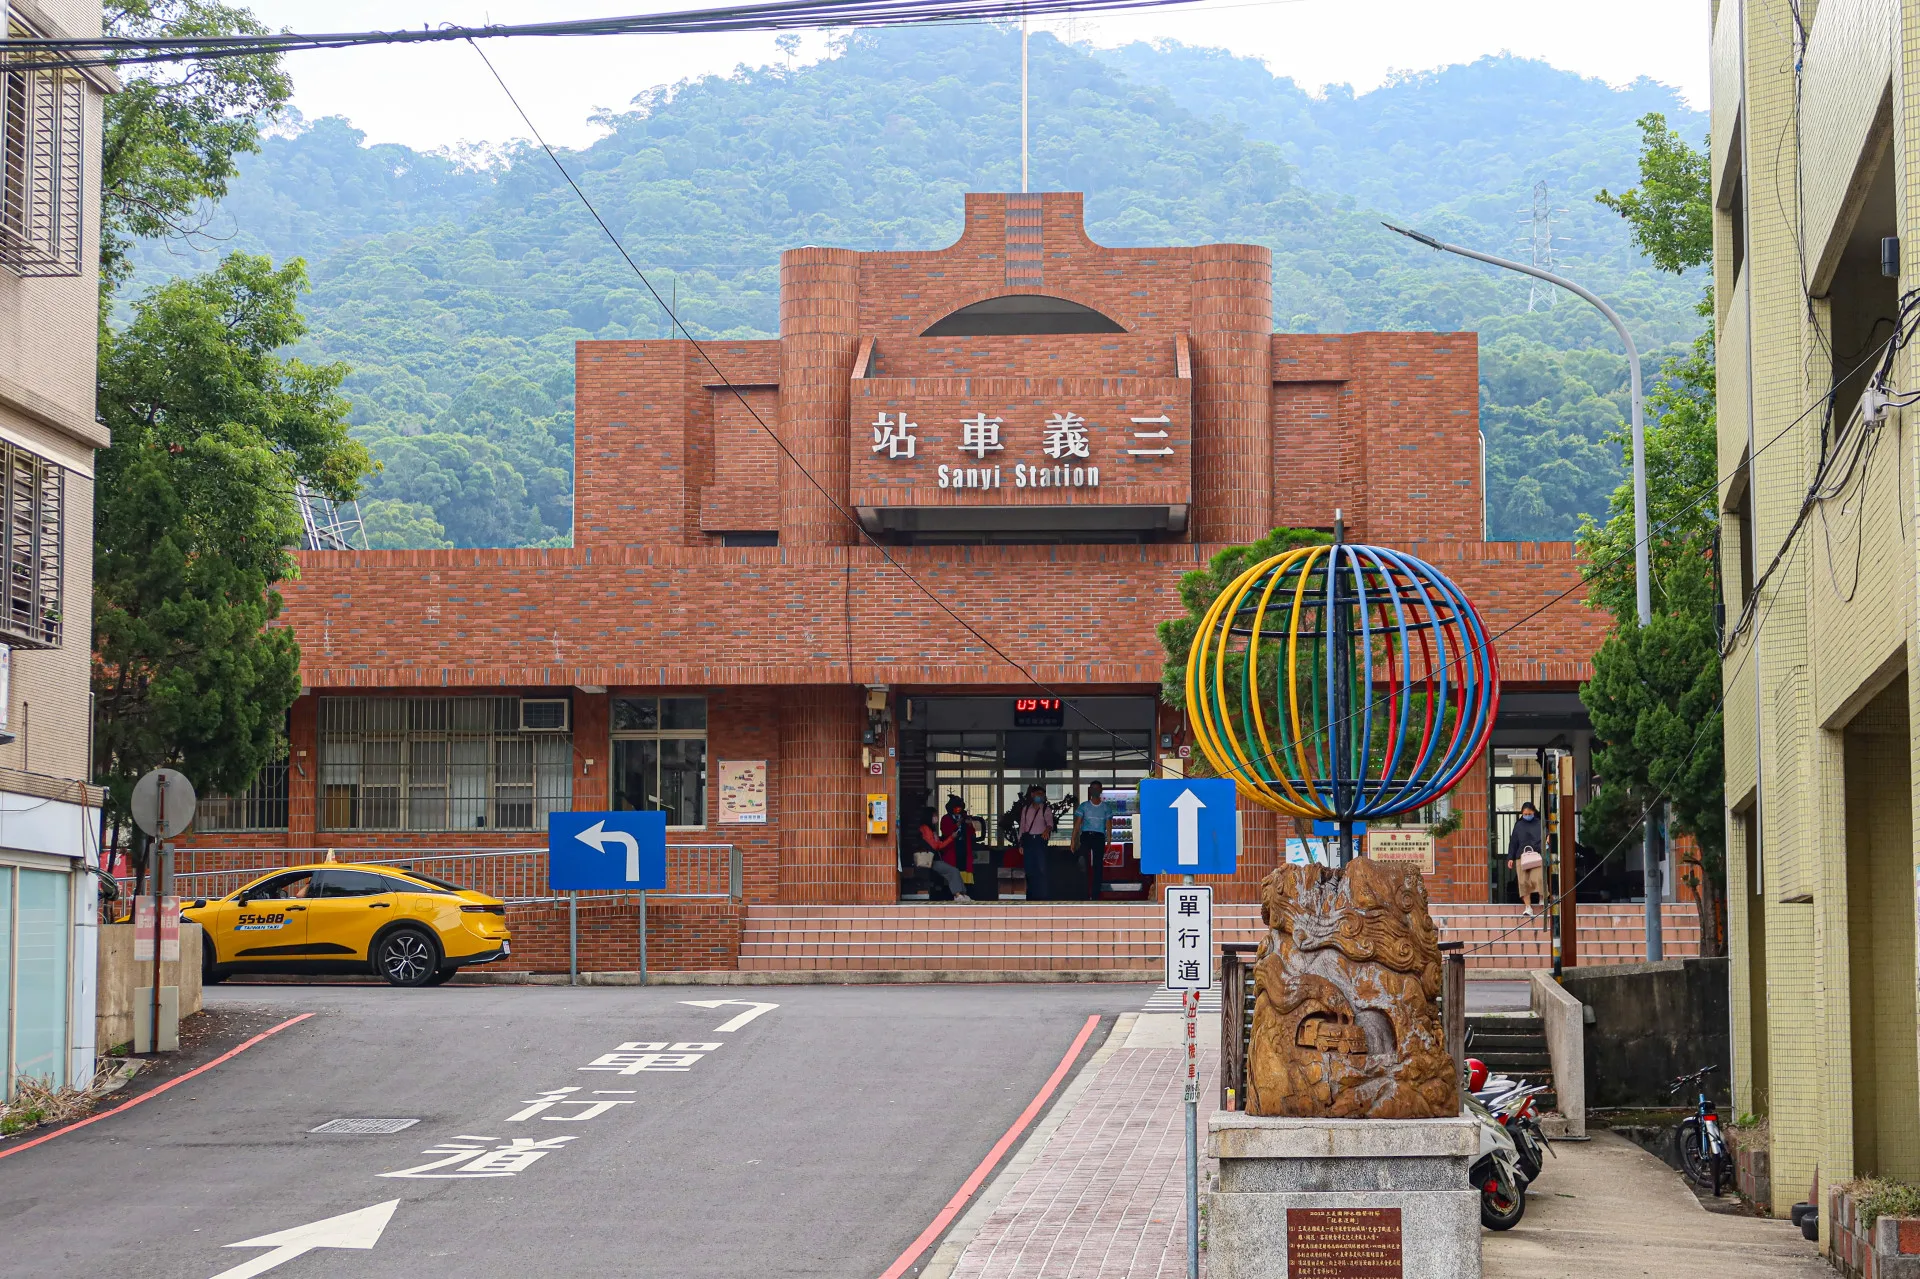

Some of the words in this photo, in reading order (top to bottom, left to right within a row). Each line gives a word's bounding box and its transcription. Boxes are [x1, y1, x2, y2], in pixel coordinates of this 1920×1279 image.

[938, 464, 1000, 490] Sanyi
[1015, 463, 1099, 488] Station
[238, 913, 284, 924] 55688
[1178, 896, 1200, 981] 單行道
[1187, 1002, 1197, 1080] 出租機車
[374, 1041, 724, 1178] 單行道
